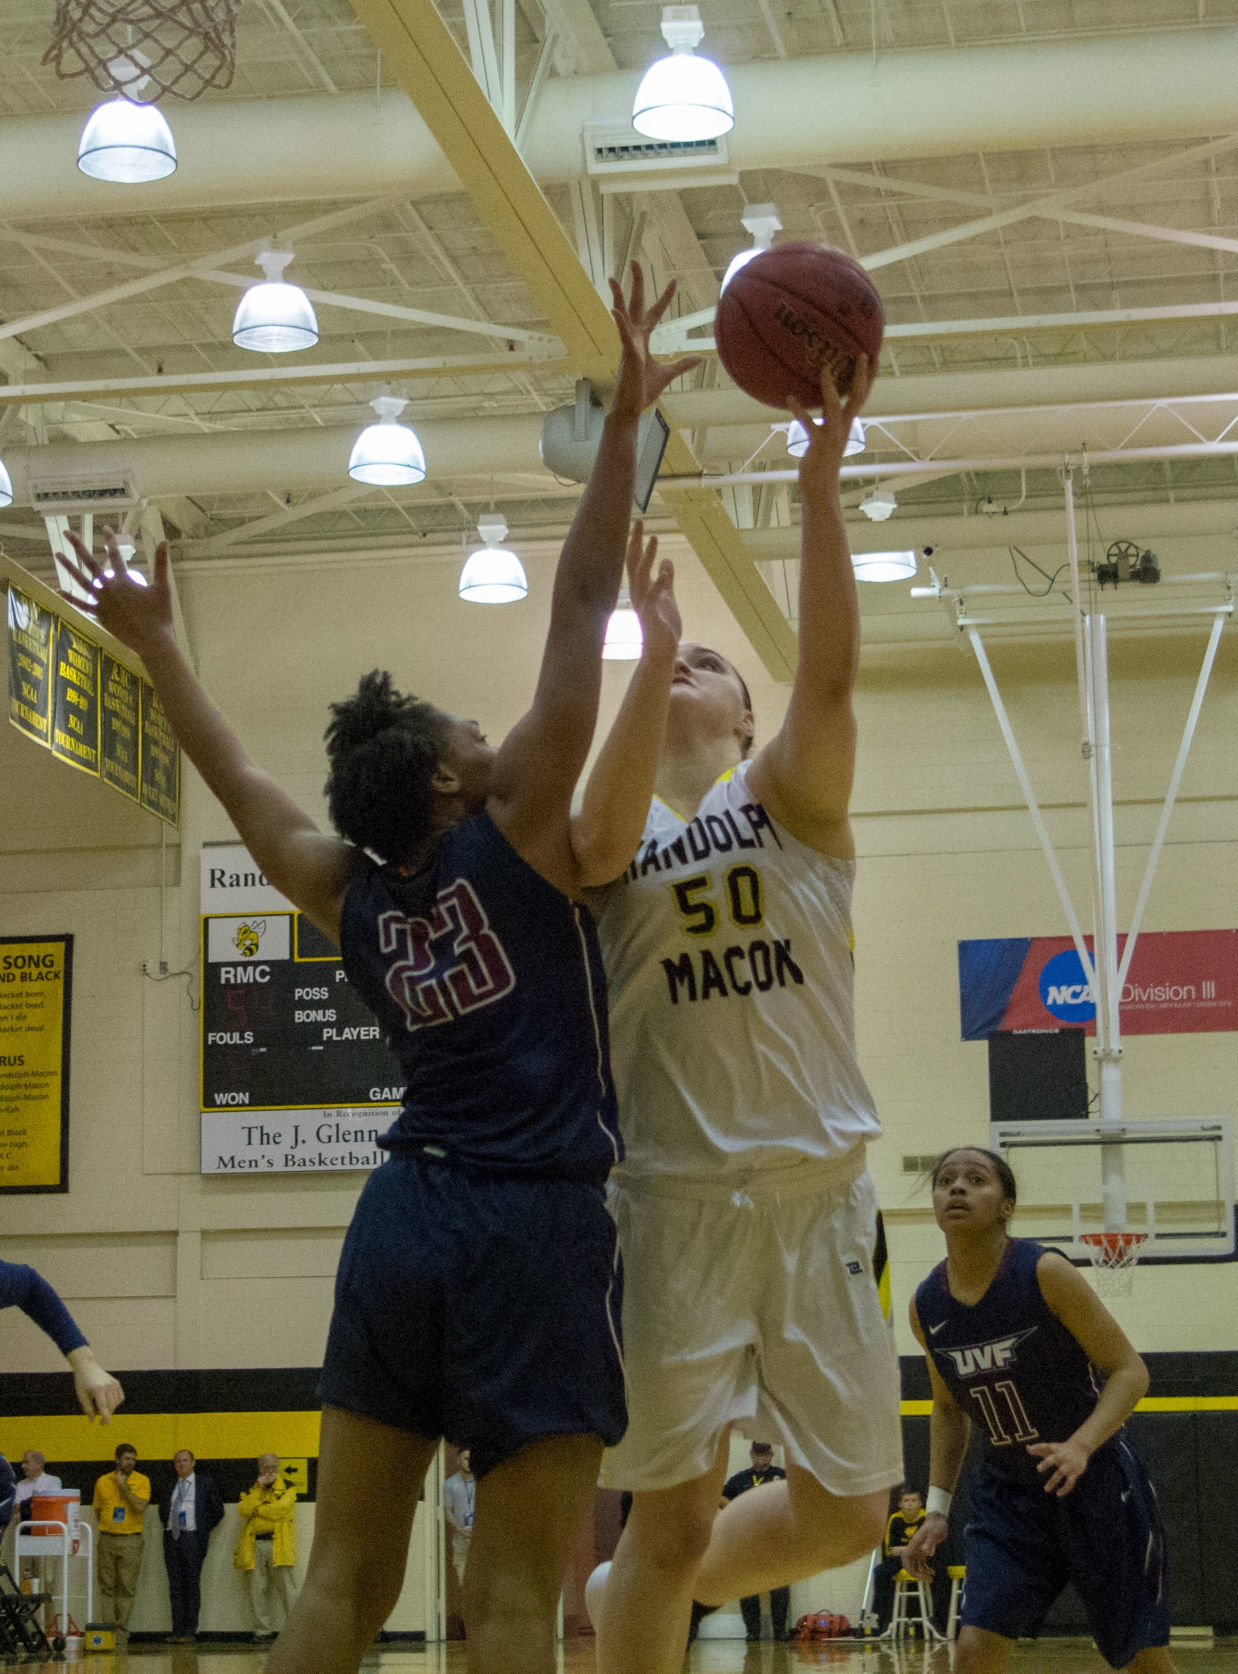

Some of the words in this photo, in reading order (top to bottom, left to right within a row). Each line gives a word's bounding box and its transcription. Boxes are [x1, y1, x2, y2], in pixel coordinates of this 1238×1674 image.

[622, 802, 784, 884] ANDOLP
[672, 863, 763, 937] 50
[2, 954, 54, 970] SONG
[377, 878, 516, 1032] 23
[20, 970, 61, 982] BLACK
[220, 965, 271, 984] RMC
[660, 939, 804, 1004] MACON
[294, 987, 329, 1000] POSS
[1119, 983, 1196, 1003] Division
[295, 1009, 337, 1023] BONUS
[207, 1032, 254, 1045] FOULS
[323, 1026, 380, 1041] PLAYER
[214, 1092, 250, 1105] WON
[241, 1125, 282, 1145] The
[290, 1125, 306, 1149] J.
[316, 1123, 379, 1144] Glenn
[215, 1154, 274, 1169] Men's
[283, 1151, 385, 1168] Basketball
[949, 1337, 1020, 1375] UVF
[969, 1380, 1039, 1446] 11
